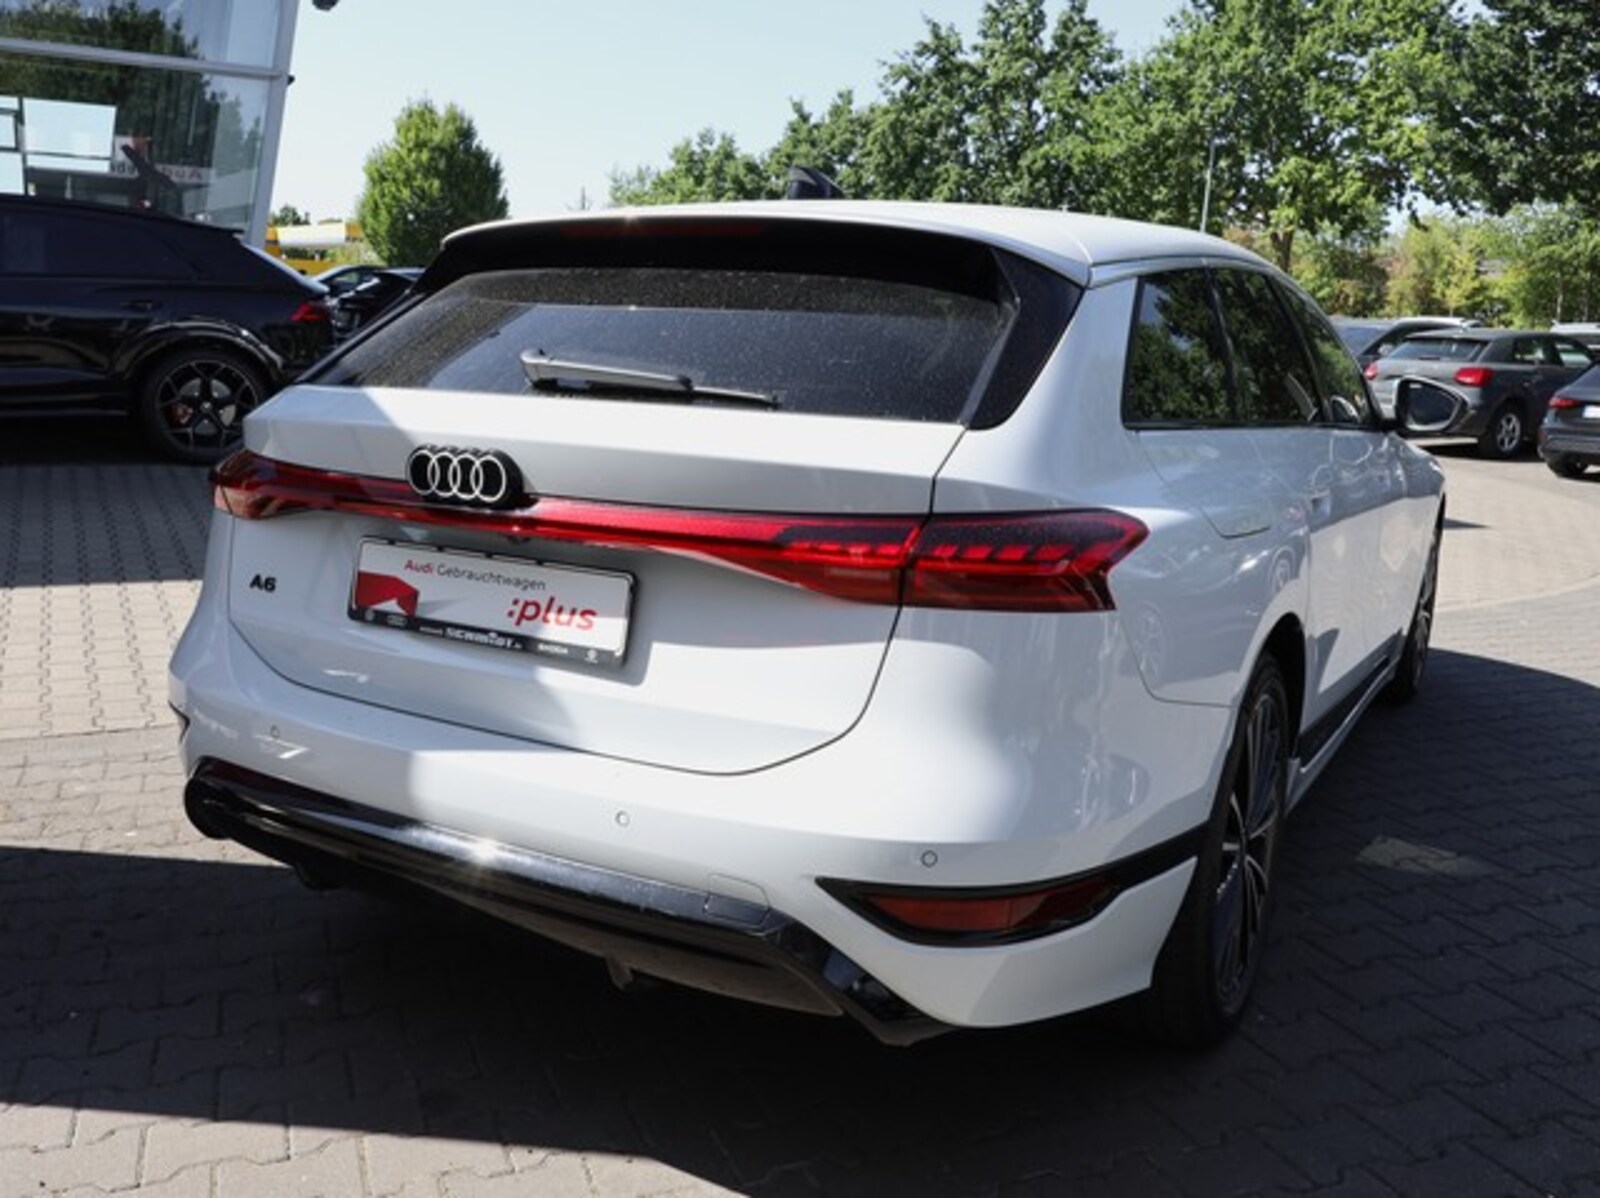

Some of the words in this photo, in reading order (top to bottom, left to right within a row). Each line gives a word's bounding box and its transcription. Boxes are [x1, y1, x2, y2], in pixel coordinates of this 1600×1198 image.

[249, 573, 276, 593] A6
[404, 559, 434, 574] Audi
[436, 563, 546, 591] Gebrauchtwagen
